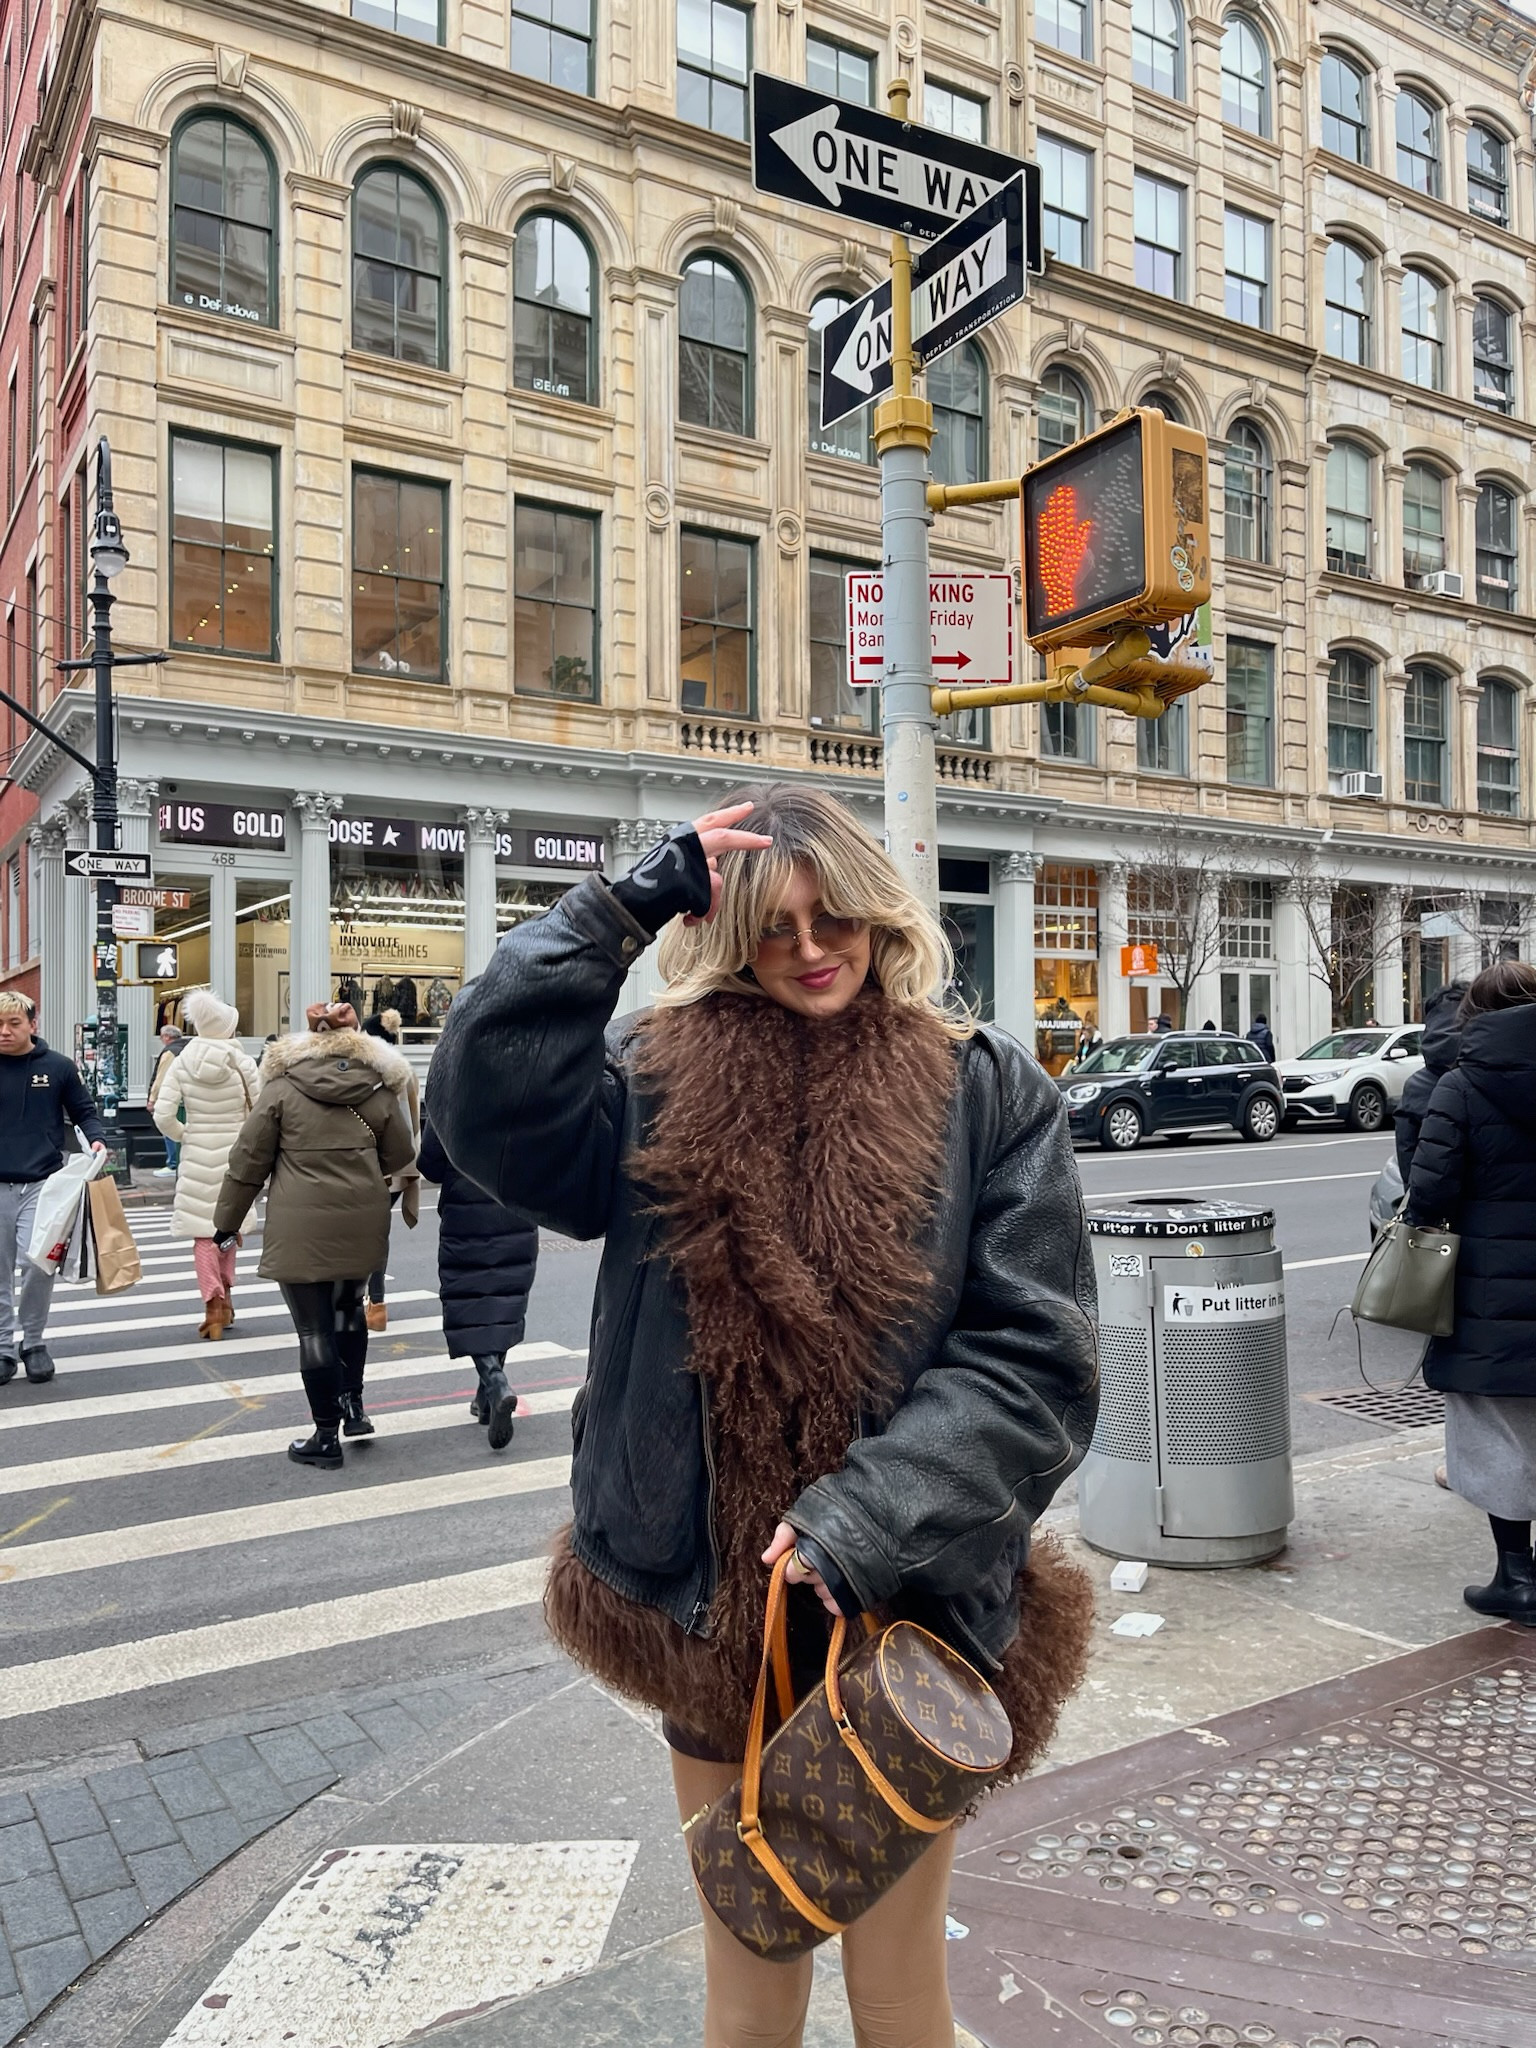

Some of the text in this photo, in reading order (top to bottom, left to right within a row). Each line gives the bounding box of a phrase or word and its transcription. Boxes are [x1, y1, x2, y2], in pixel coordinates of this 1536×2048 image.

[812, 130, 995, 215] ONE WA
[929, 236, 992, 323] WAY
[925, 292, 1016, 360] DEPT OF TRANSPORTATION
[855, 315, 893, 372] ON
[857, 584, 974, 603] NO KING
[930, 610, 974, 630] Friday
[177, 806, 205, 832] US
[233, 810, 286, 839] GOLD
[327, 819, 374, 846] OOSE
[211, 853, 236, 865] 468
[534, 836, 596, 864] GOLDEN
[78, 858, 140, 871] ONE WAY
[123, 888, 186, 908] BROOME ST
[340, 924, 357, 934] WE
[339, 935, 400, 949] INNOVATE
[1035, 1019, 1083, 1030] PARAJUMPERS
[1166, 1222, 1209, 1235] Don't
[1214, 1220, 1246, 1233] litter
[1202, 1298, 1231, 1312] Put
[1235, 1296, 1267, 1311] litter
[1268, 1294, 1277, 1307] in
